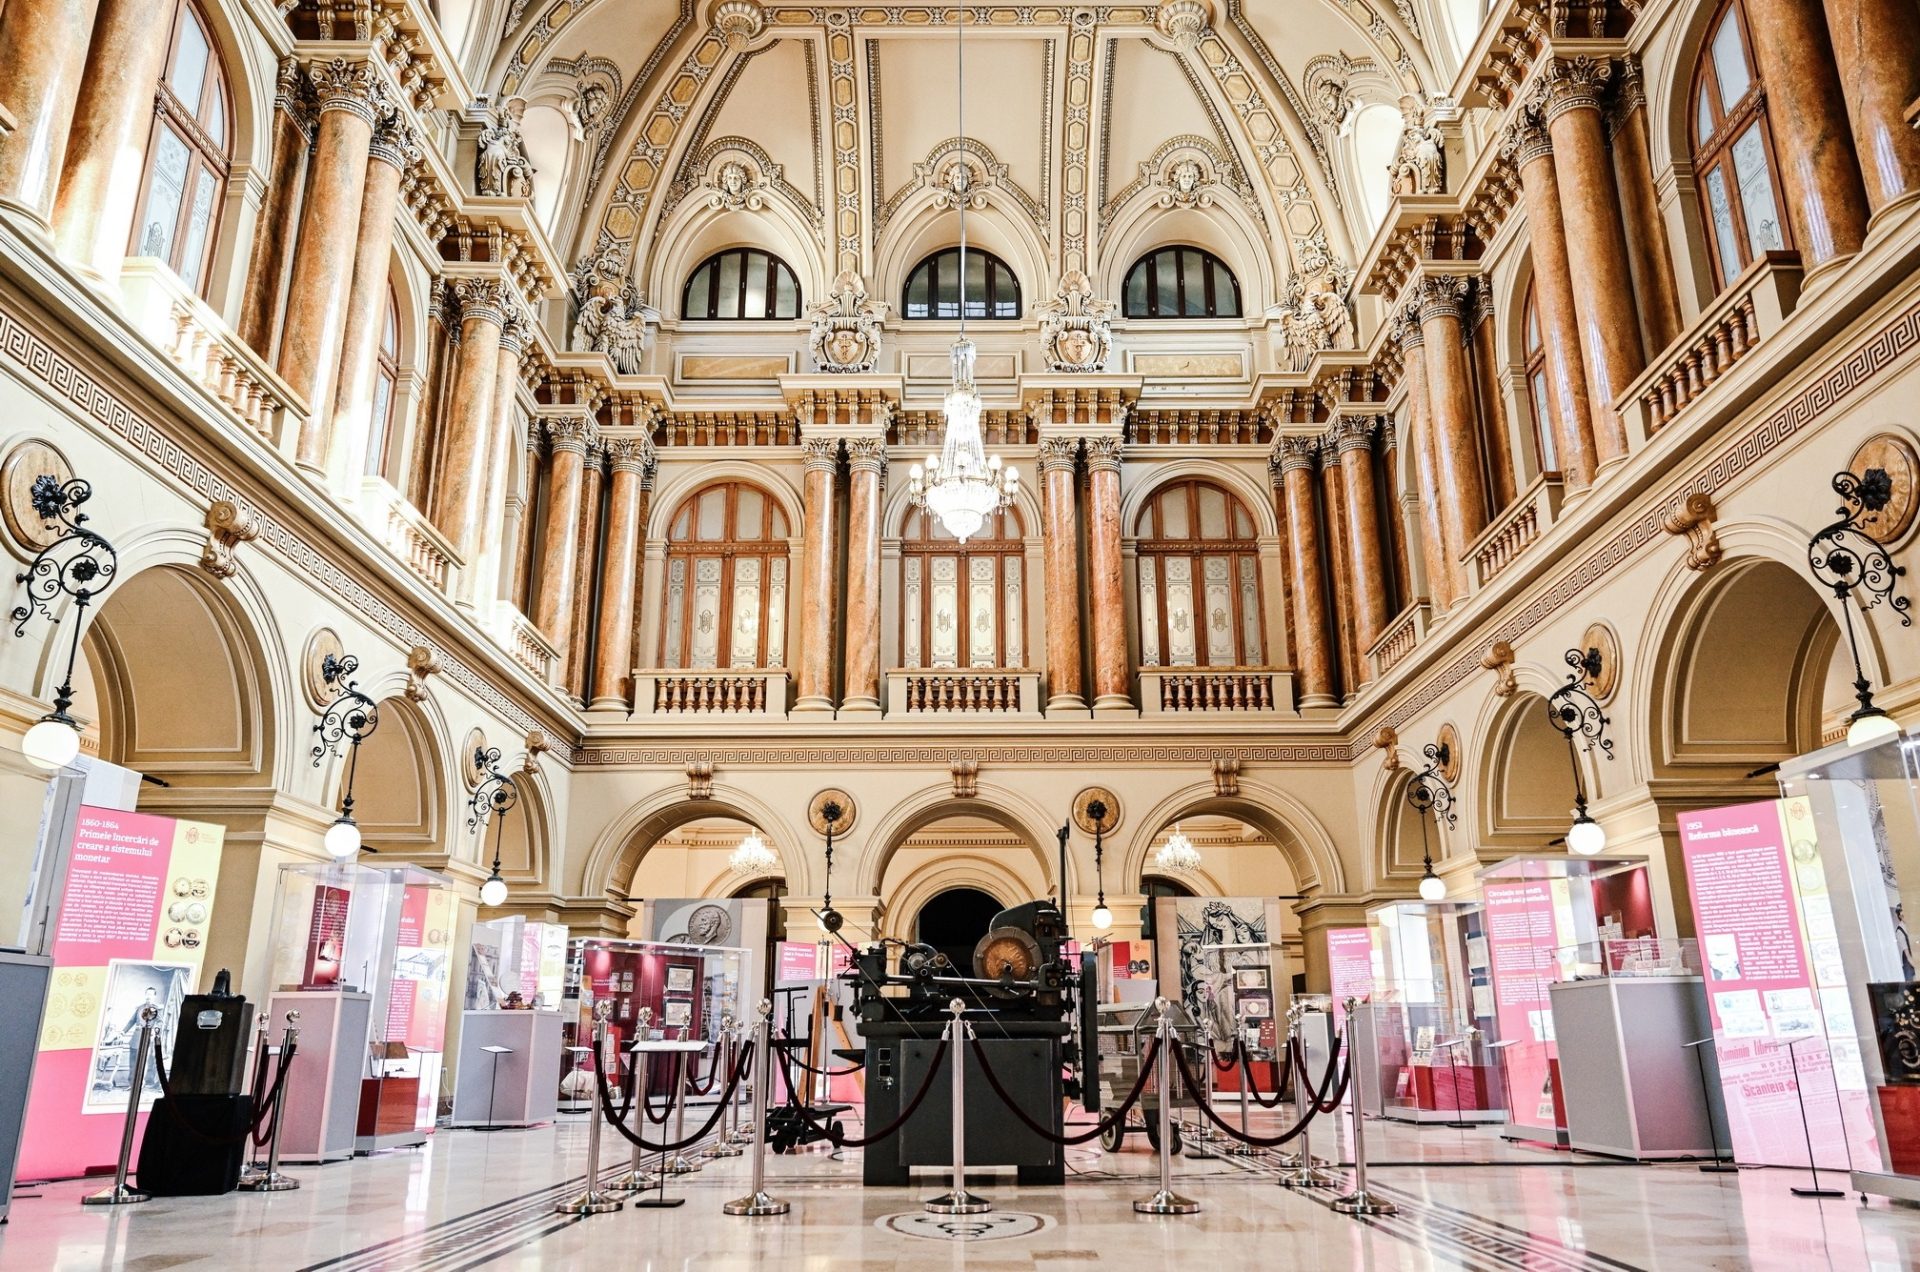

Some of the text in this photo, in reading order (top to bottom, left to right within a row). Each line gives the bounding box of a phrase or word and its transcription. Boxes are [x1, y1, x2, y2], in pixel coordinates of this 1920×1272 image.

[80, 829, 112, 840] Primele
[149, 837, 159, 846] de
[77, 842, 103, 851] creare
[111, 844, 152, 857] sistemului
[75, 854, 111, 864] monetar
